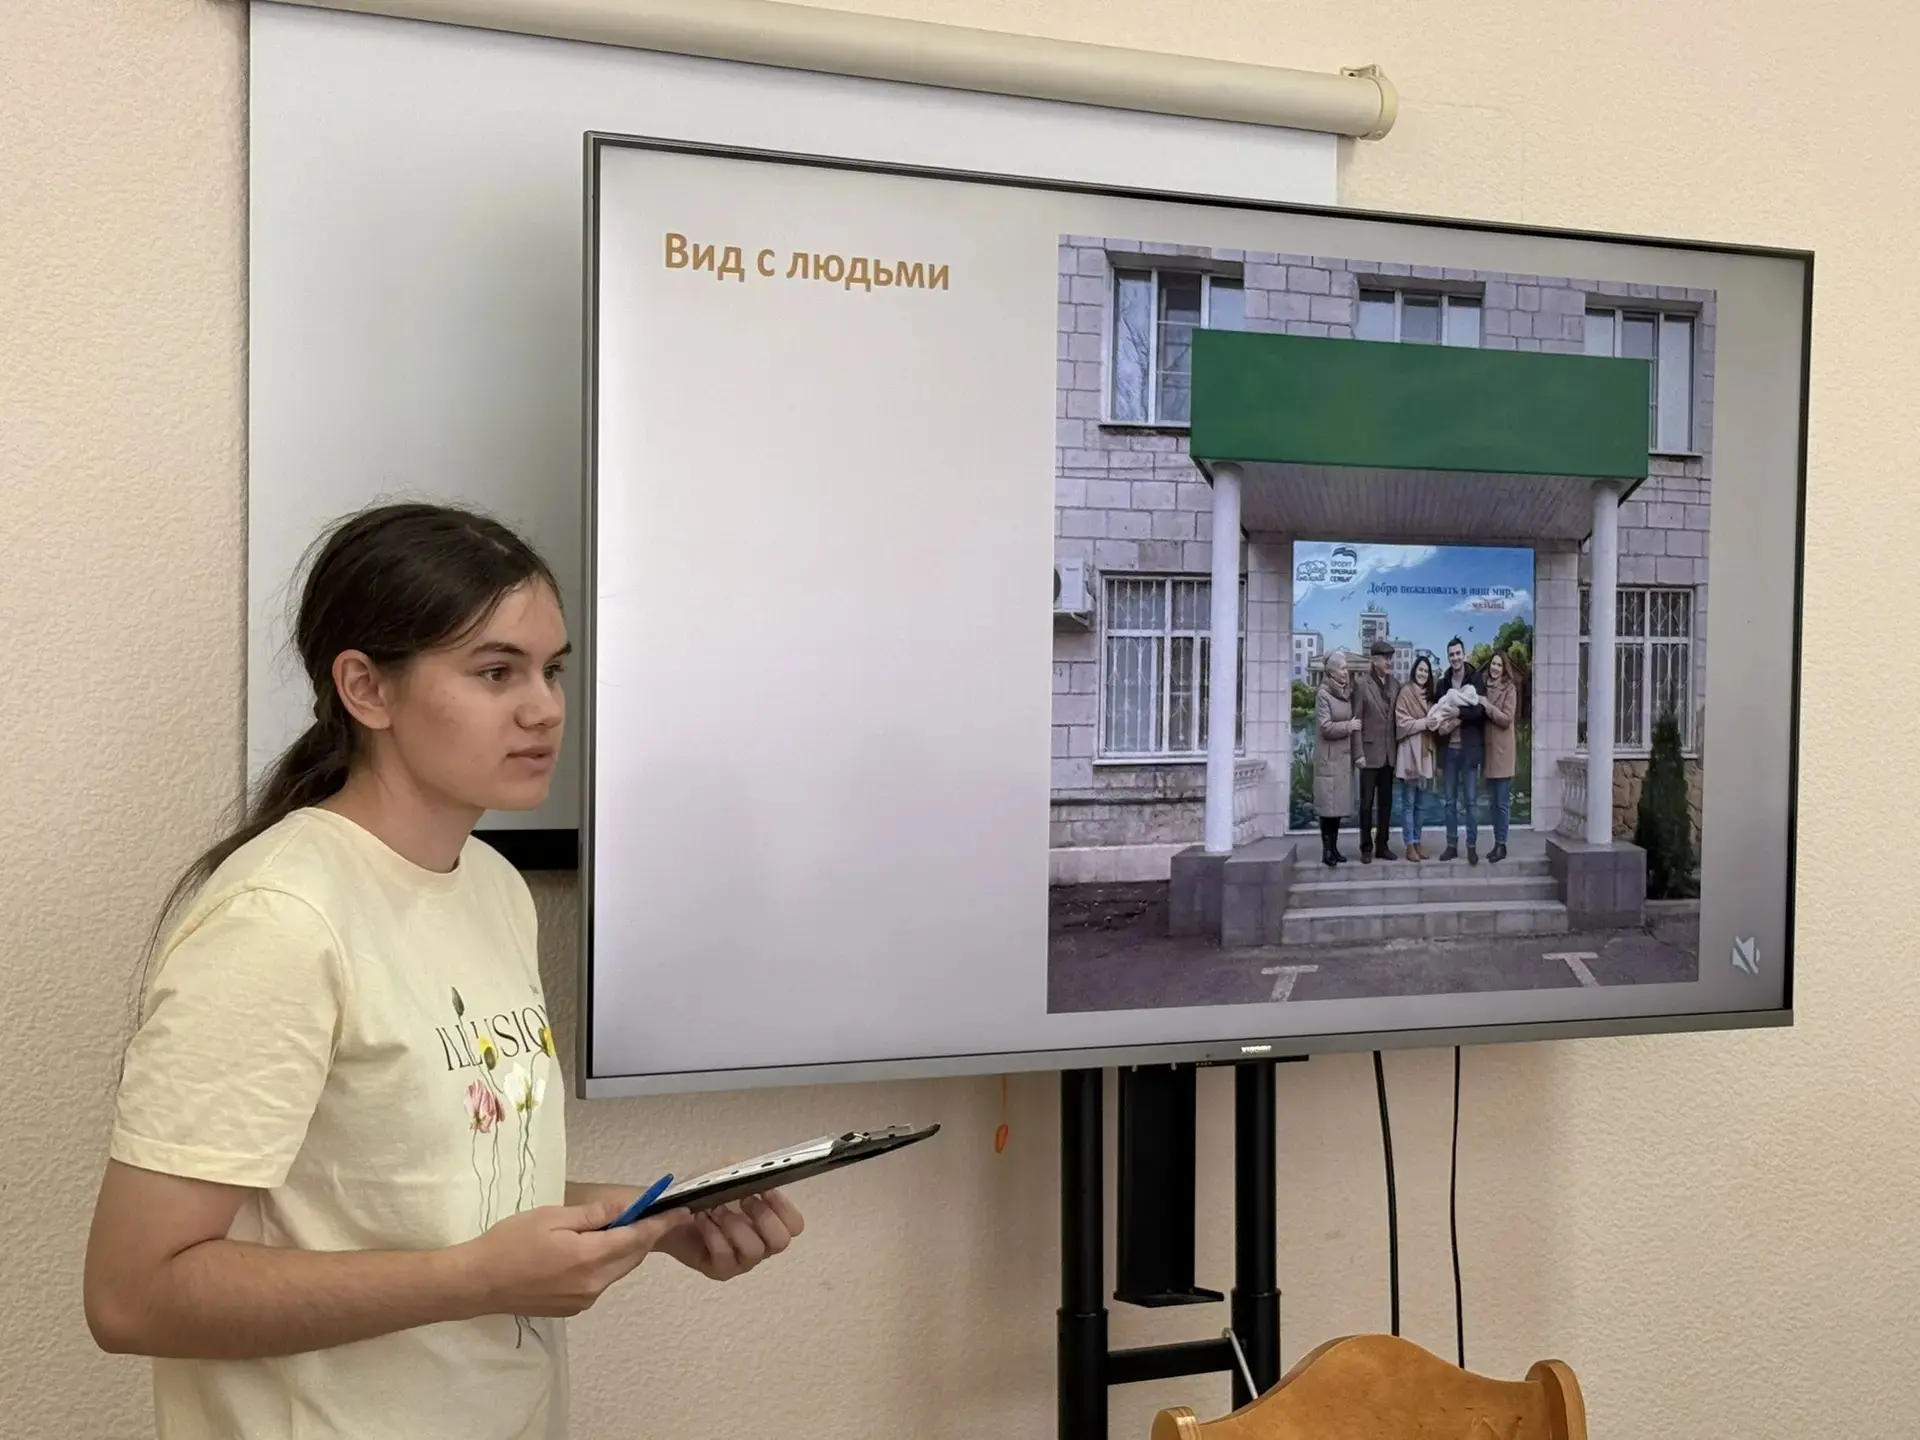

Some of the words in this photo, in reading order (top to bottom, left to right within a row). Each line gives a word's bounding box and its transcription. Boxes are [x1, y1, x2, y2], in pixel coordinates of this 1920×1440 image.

[665, 232, 745, 283] Вид
[757, 249, 775, 277] с
[786, 252, 949, 292] людьми
[1366, 582, 1398, 596] Добро
[1400, 585, 1458, 596] пожаловать
[1461, 587, 1468, 596] в
[1469, 587, 1489, 596] наш
[1492, 588, 1514, 599] мир,
[435, 1004, 548, 1071] ILLUSIO
